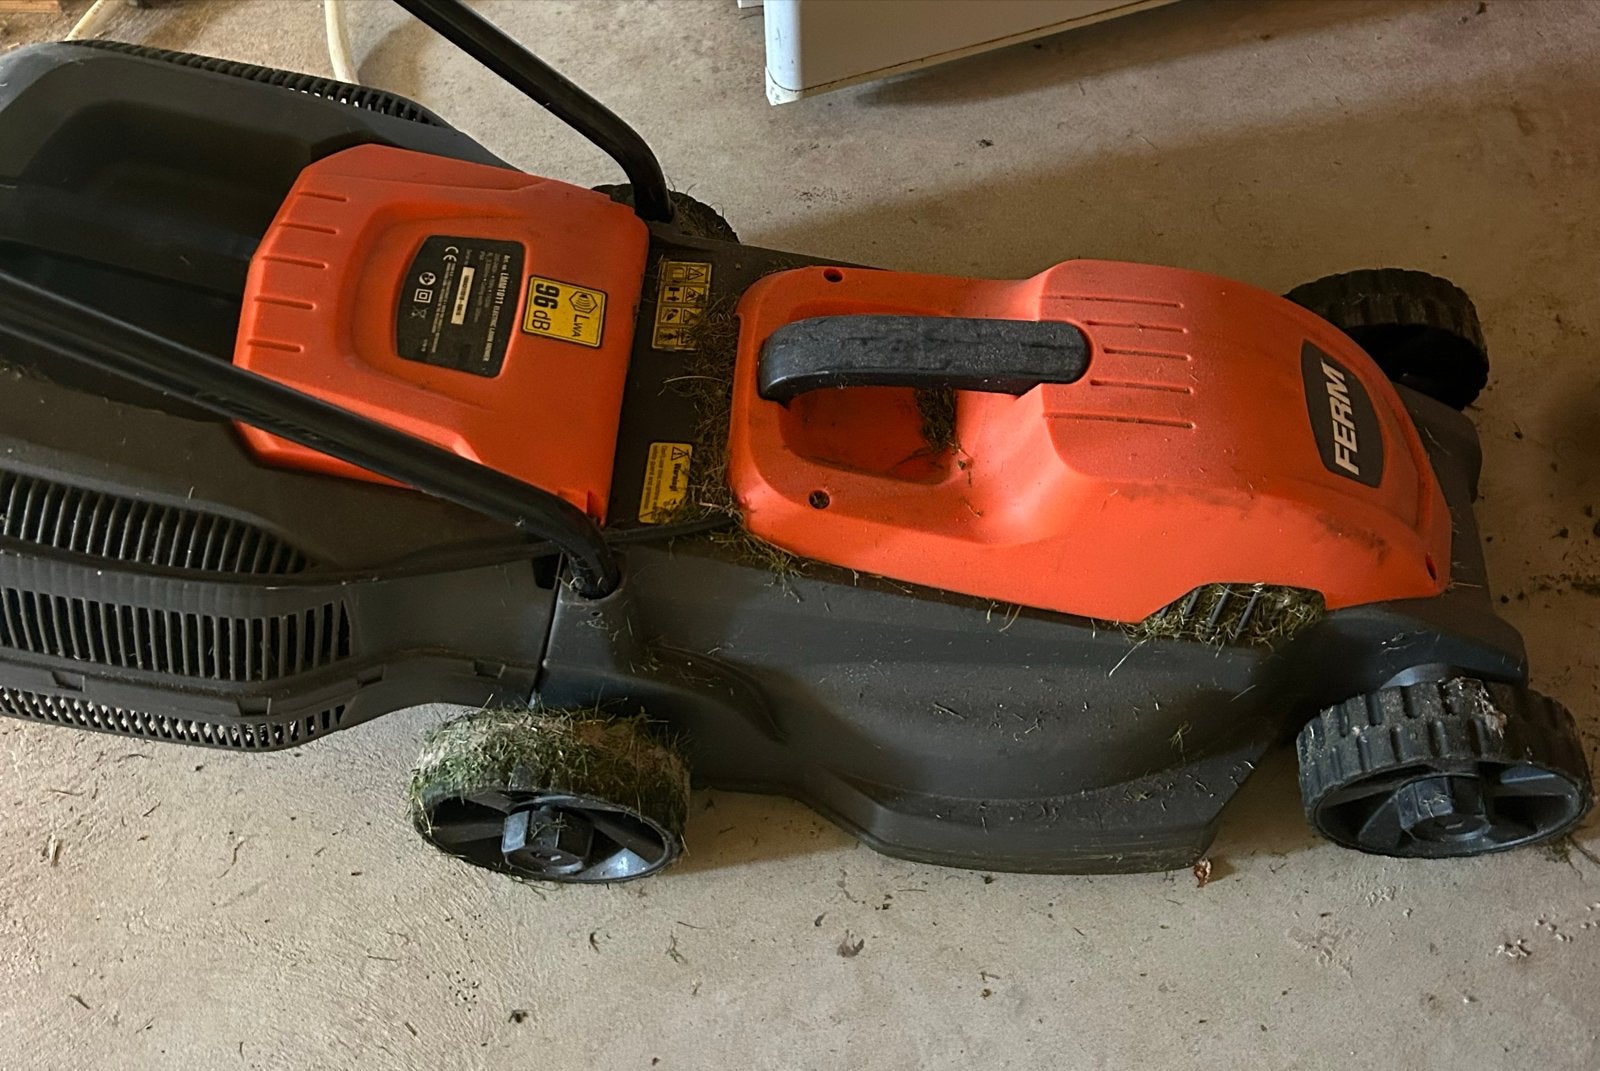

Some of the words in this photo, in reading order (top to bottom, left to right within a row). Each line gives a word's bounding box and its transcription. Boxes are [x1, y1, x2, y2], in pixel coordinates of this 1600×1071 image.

[533, 283, 560, 309] 96
[531, 310, 552, 331] dB
[1320, 361, 1360, 476] FERM
